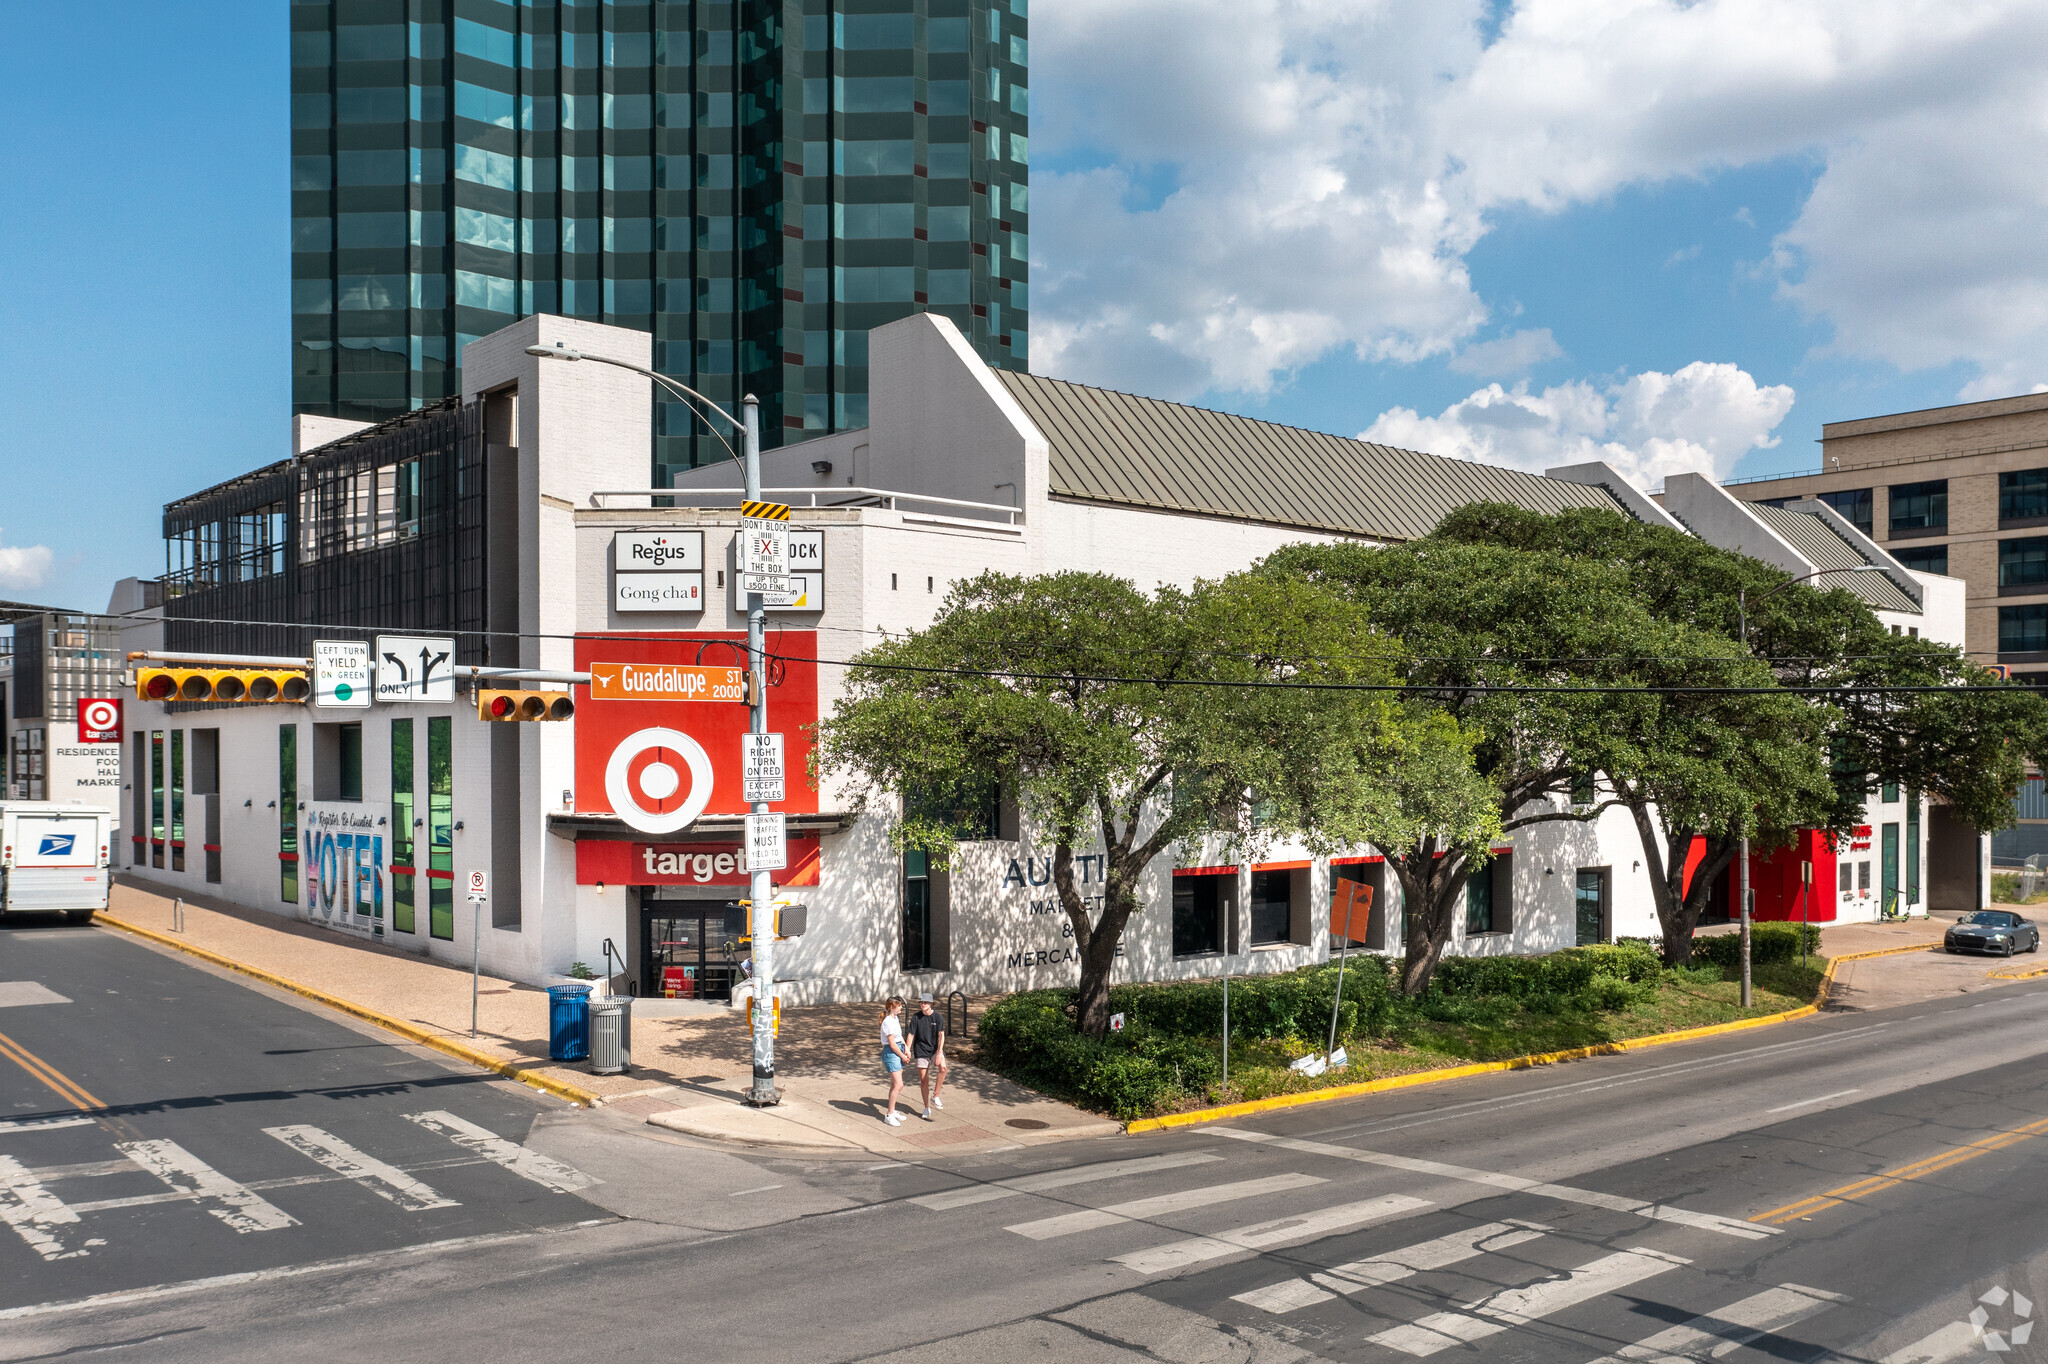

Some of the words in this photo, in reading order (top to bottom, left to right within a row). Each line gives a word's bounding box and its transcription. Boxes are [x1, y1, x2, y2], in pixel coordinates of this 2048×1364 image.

[765, 521, 788, 533] BLOCK
[632, 543, 685, 566] Regus
[789, 543, 817, 558] OCK
[751, 562, 765, 573] THE
[768, 564, 783, 573] BOX
[748, 582, 767, 590] $500
[770, 583, 785, 591] FINE
[620, 585, 660, 603] Gong
[662, 585, 688, 599] cha
[763, 595, 785, 603] eview
[317, 646, 338, 655] LEFT
[343, 646, 366, 655] TURN
[328, 657, 357, 668] YIELD
[320, 670, 332, 679] ON
[338, 671, 365, 680] GREEN
[622, 665, 706, 699] Guadalupe
[726, 670, 740, 684] ST
[380, 684, 410, 694] ONLY
[712, 685, 741, 698] 2000
[85, 730, 118, 740] target
[755, 735, 771, 746] NO
[56, 748, 118, 756] RESIDENCE
[750, 747, 776, 757] RIGHT
[96, 758, 120, 766] FOO
[752, 757, 776, 766] TURN
[97, 768, 120, 776] HAL
[747, 767, 760, 776] ON
[763, 766, 781, 776] RED
[76, 779, 120, 787] MARKE
[749, 781, 779, 789] EXCEPT
[747, 790, 782, 799] BICYCLES
[753, 825, 778, 834] TRAFFIC
[754, 835, 778, 847] MUST
[642, 847, 749, 883] target
[1002, 854, 1105, 889] AUTI
[1061, 923, 1074, 938] &
